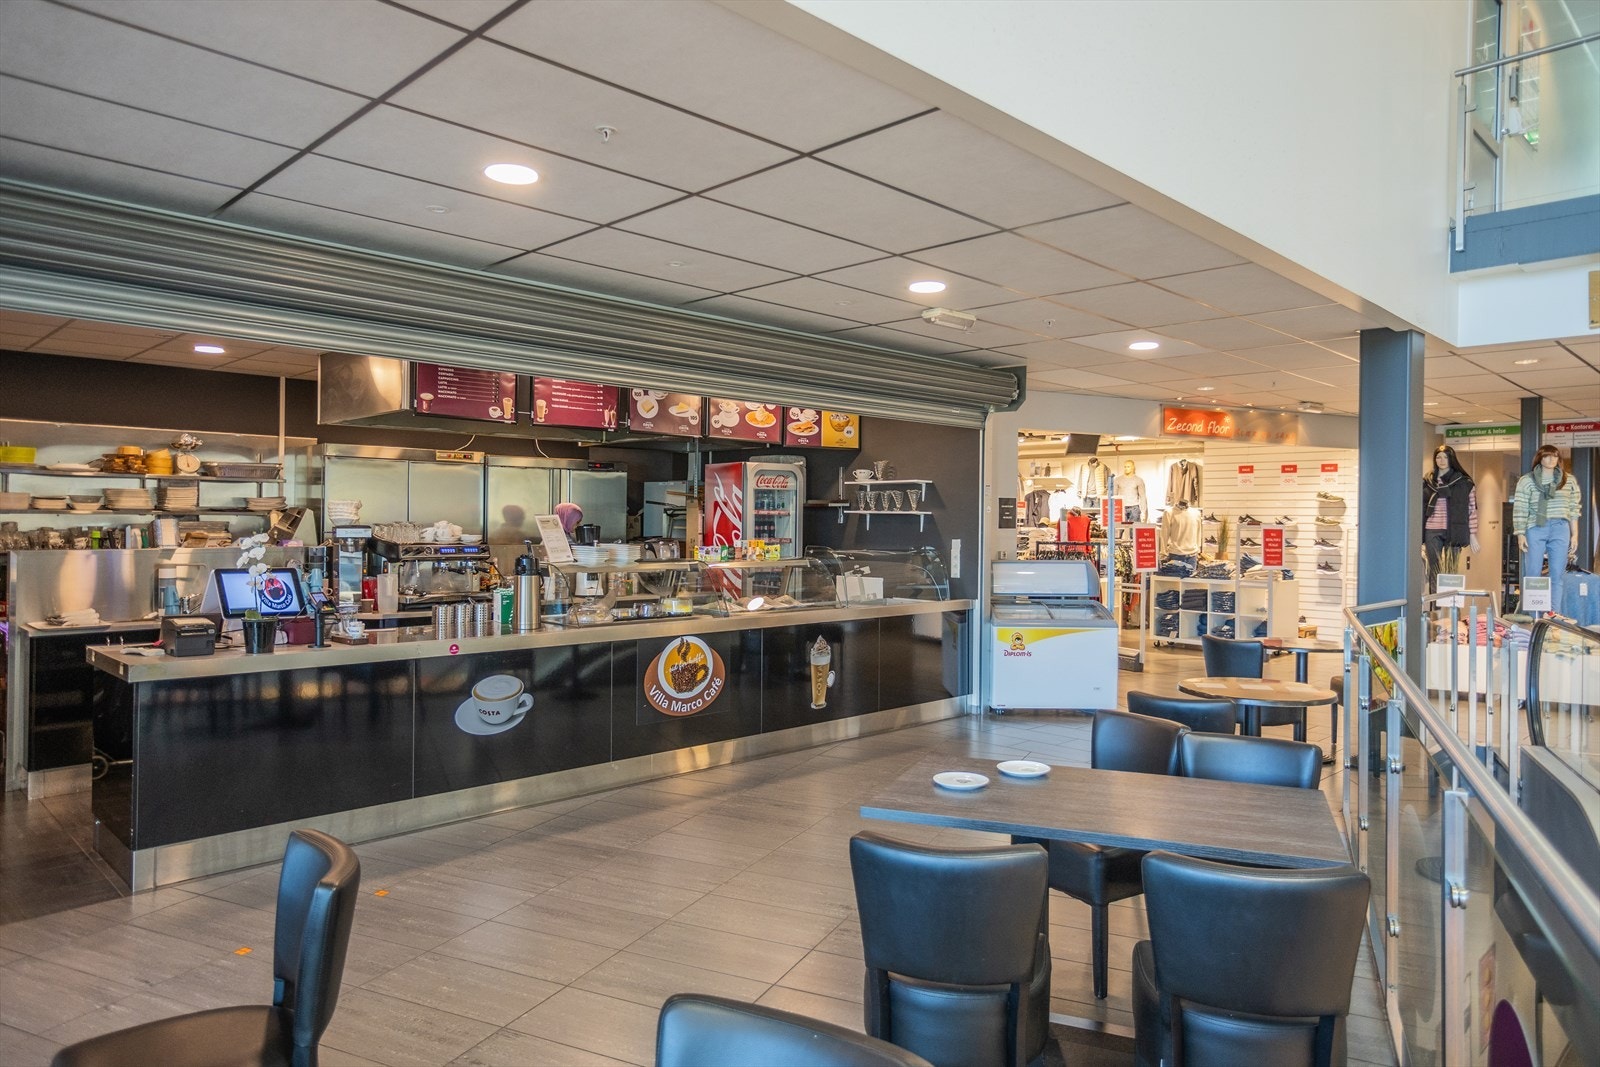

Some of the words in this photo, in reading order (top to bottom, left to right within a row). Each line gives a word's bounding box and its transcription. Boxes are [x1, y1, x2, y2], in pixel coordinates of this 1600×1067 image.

[1167, 417, 1204, 433] Zecond
[1207, 420, 1230, 434] floor
[649, 684, 669, 709] Villa
[670, 698, 703, 713] Marco
[704, 677, 722, 701] Café
